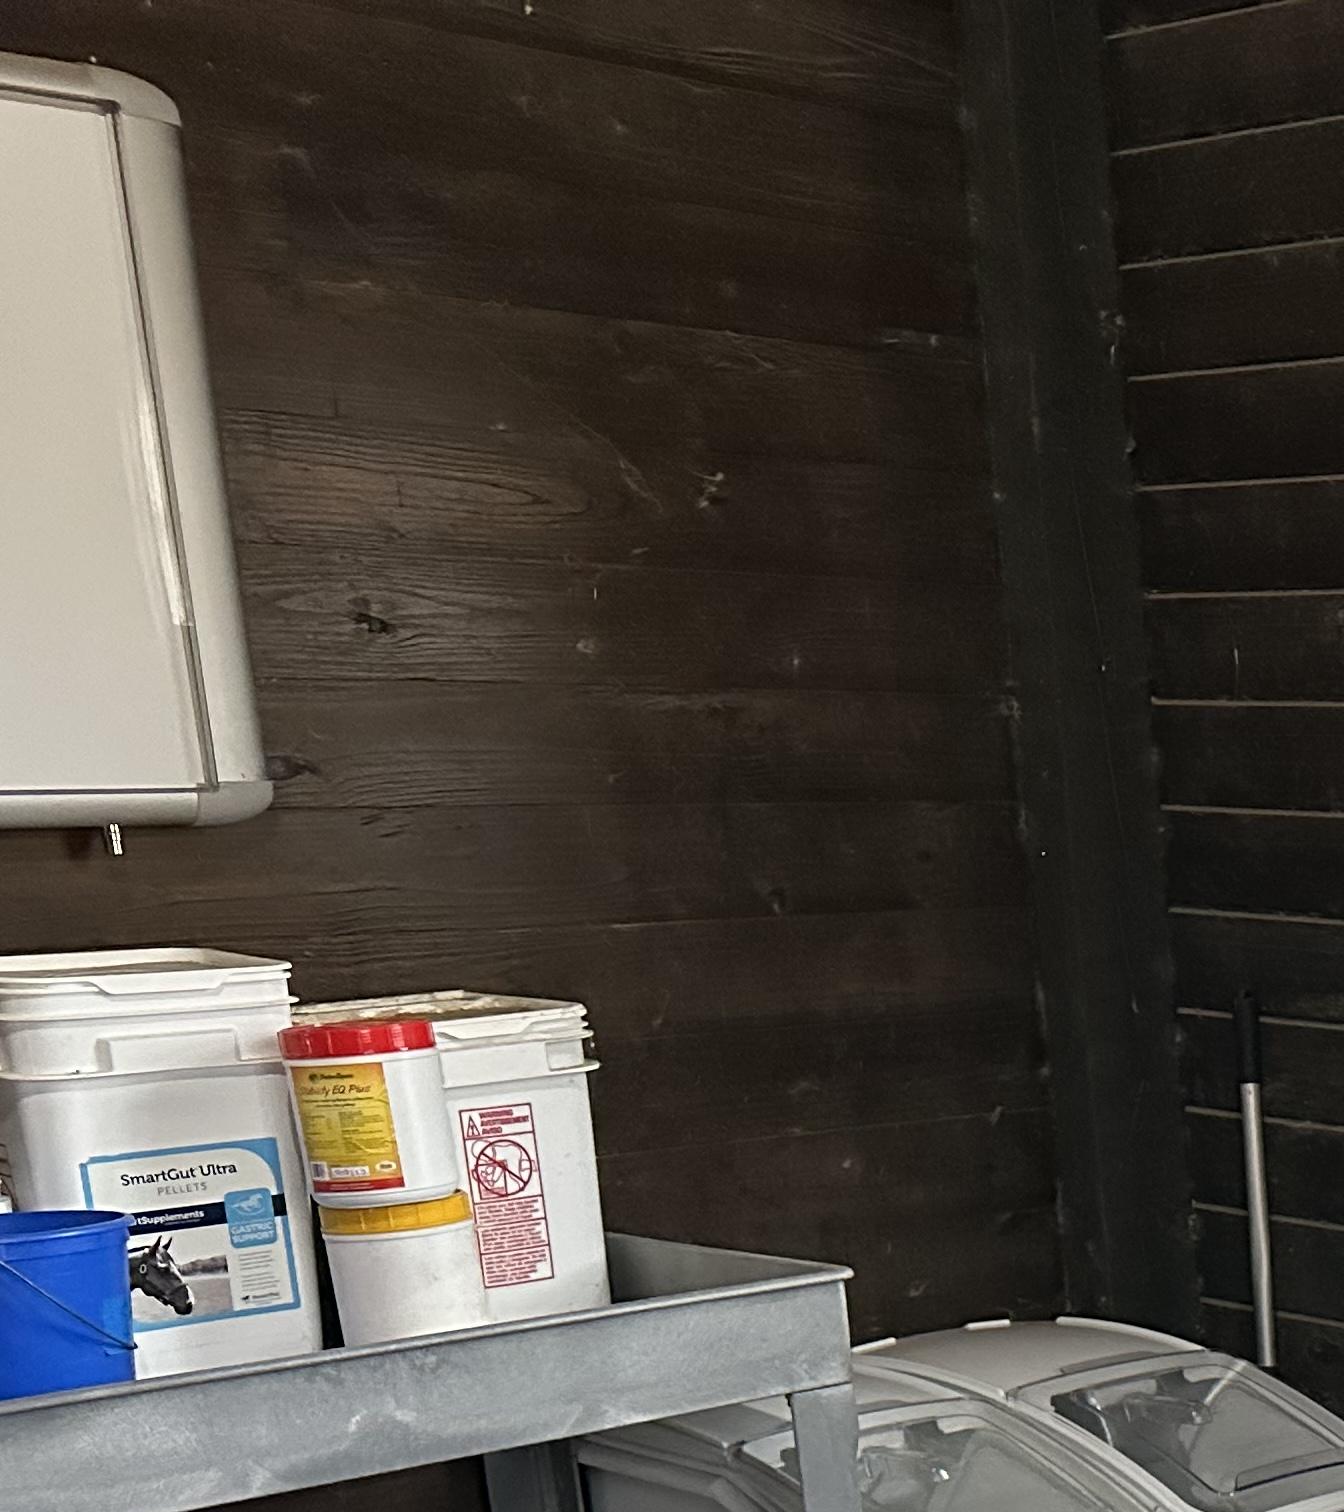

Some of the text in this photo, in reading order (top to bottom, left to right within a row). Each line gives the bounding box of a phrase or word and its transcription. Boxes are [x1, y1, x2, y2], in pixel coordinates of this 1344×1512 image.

[120, 1163, 237, 1187] SmartGut Ultra
[157, 1182, 207, 1196] PELLETS
[134, 1210, 205, 1227] tSupplements
[231, 1222, 274, 1236] GASTRIC
[232, 1230, 275, 1243] SUPPORT
